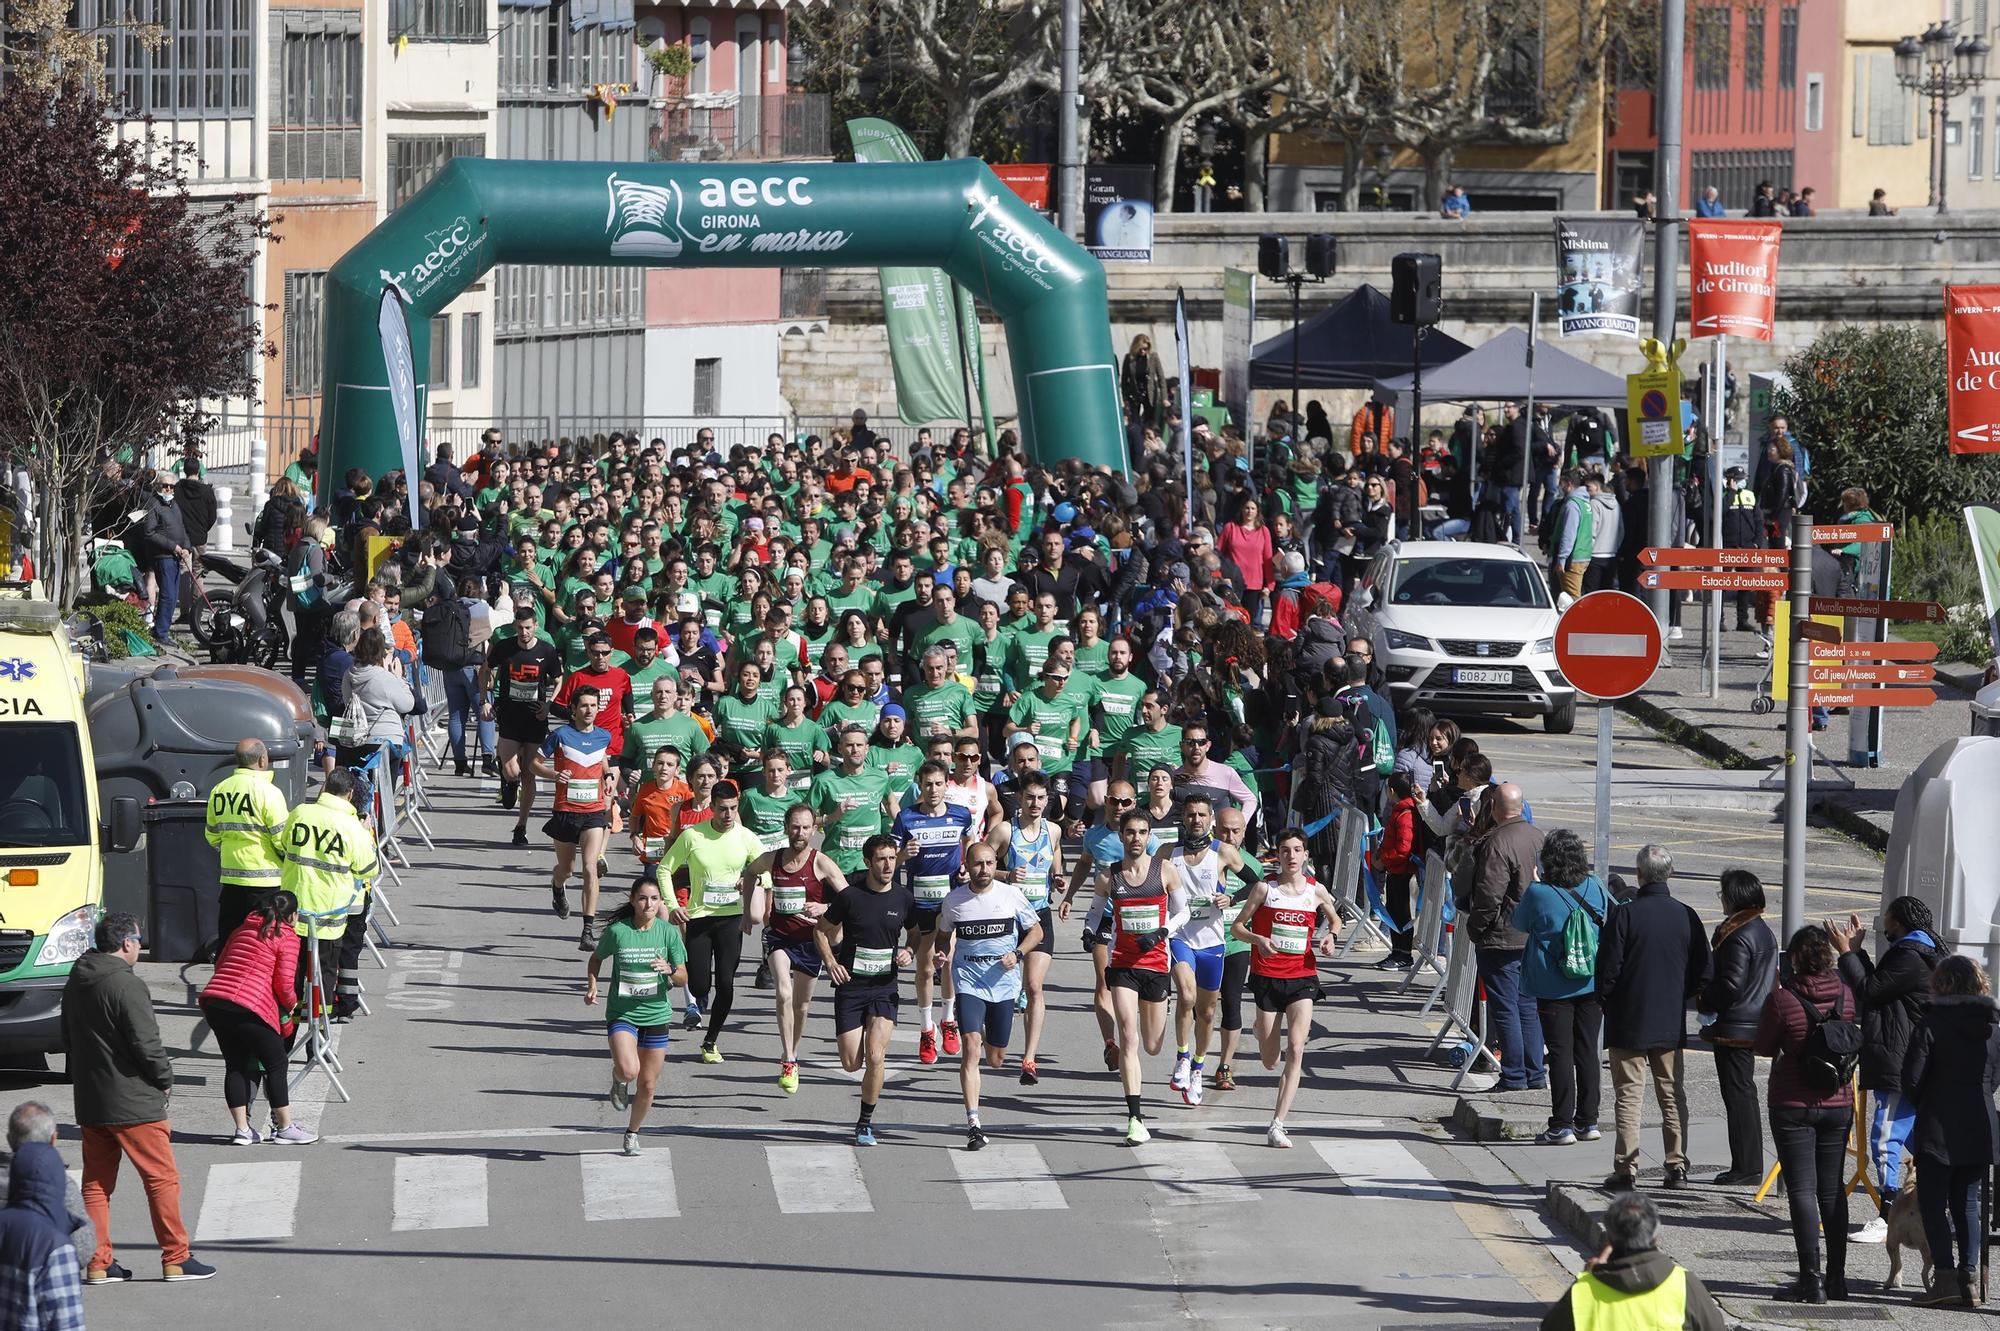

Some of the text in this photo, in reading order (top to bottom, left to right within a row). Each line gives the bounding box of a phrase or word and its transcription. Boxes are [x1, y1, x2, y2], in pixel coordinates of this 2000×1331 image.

[699, 176, 814, 208] aecc
[1089, 184, 1115, 193] Goran
[700, 214, 761, 229] GIRONA
[699, 228, 854, 252] en marxa
[1561, 239, 1609, 250] Mishima
[411, 226, 470, 283] aecc
[1704, 260, 1768, 278] Auditori
[1696, 278, 1771, 297] de Girona
[1954, 306, 1983, 314] HIVERN
[1564, 318, 1636, 332] LA VANGUARDIA
[1956, 371, 1983, 391] de
[1811, 528, 1857, 540] Oficina de Turisme
[1719, 552, 1785, 564] Estació de trens
[1701, 575, 1785, 587] Estació d'autobusos
[1814, 601, 1880, 615] Muralla medieval
[1814, 646, 1846, 657] Catedral
[1459, 671, 1510, 682] 6082 JYC
[1813, 669, 1876, 683] Call jueu/Museus
[1813, 693, 1854, 705] Ajuntament
[213, 792, 255, 816] DYA
[291, 823, 345, 858] DYA
[922, 890, 942, 899] 1619
[959, 923, 1005, 935] TGCB INN
[1131, 921, 1152, 930] 1588
[1280, 940, 1299, 949] 1584
[628, 987, 650, 996] 1642
